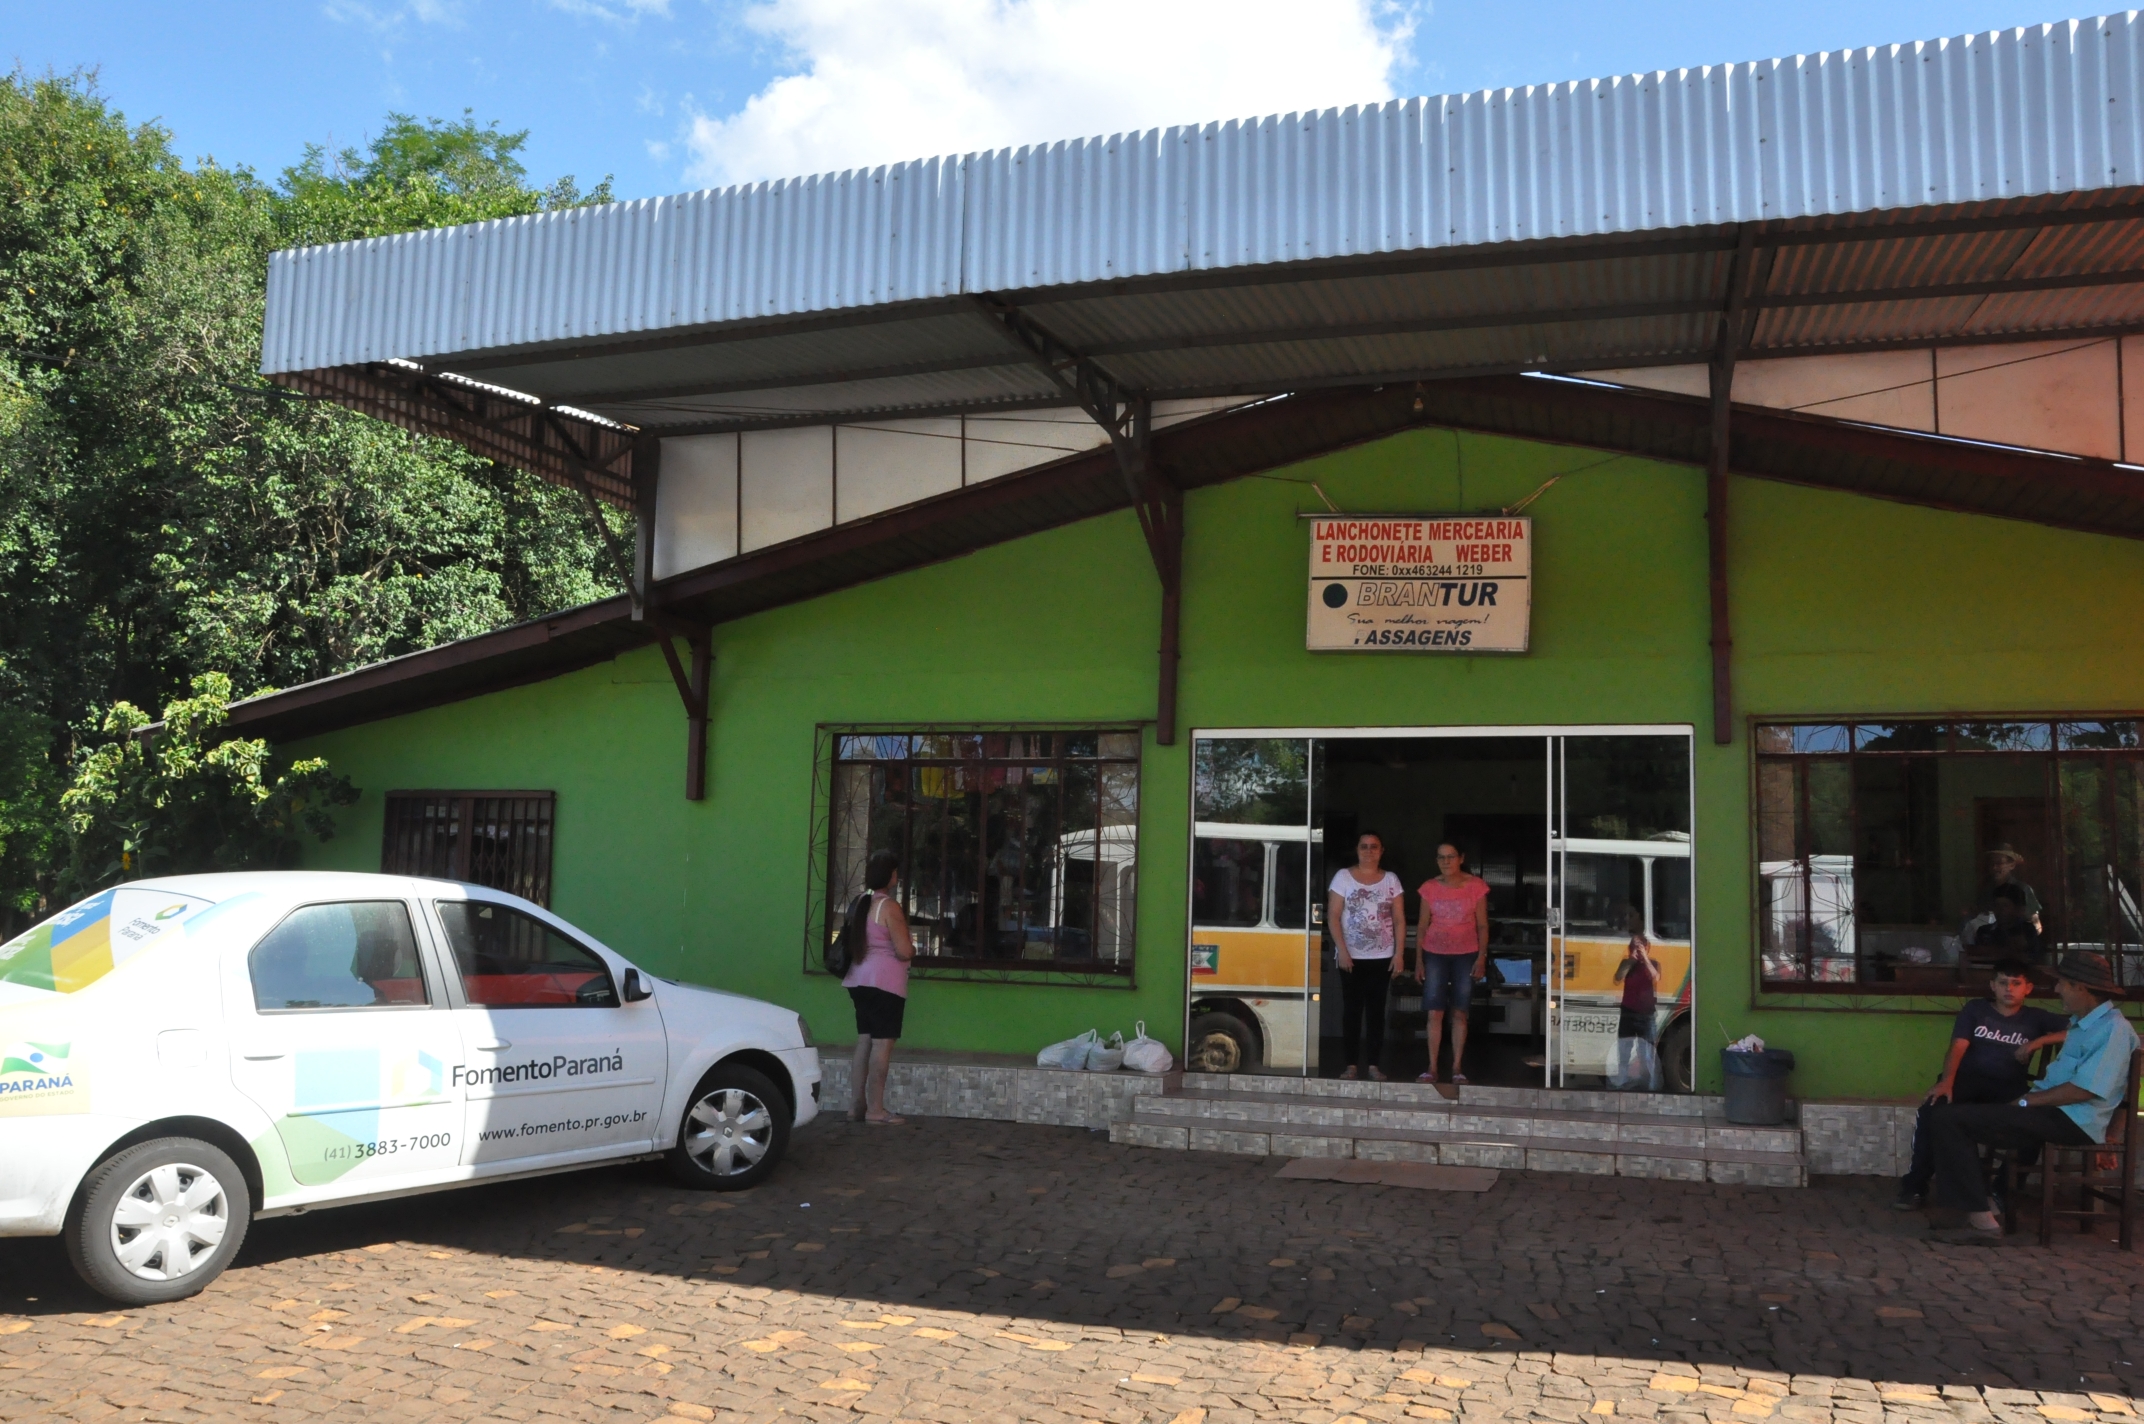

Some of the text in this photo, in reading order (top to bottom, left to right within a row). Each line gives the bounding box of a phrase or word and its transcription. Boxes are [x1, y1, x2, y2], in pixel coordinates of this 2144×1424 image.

[1316, 521, 1524, 541] LANCHONETE MERCEARIA
[1322, 541, 1512, 563] E RODOVIÁRIA WEBER
[1352, 564, 1483, 576] FONE: 0xx463244 1219
[1357, 582, 1498, 607] BRANTUR
[1347, 613, 1373, 625] Sua
[1384, 614, 1428, 625] melhor
[0, 1073, 73, 1094] PARANÁ
[48, 1089, 75, 1097] ESTADO
[478, 1109, 648, 1142] www.fomento.pr.gov.br
[323, 1132, 452, 1162] (41) 3883-7000
